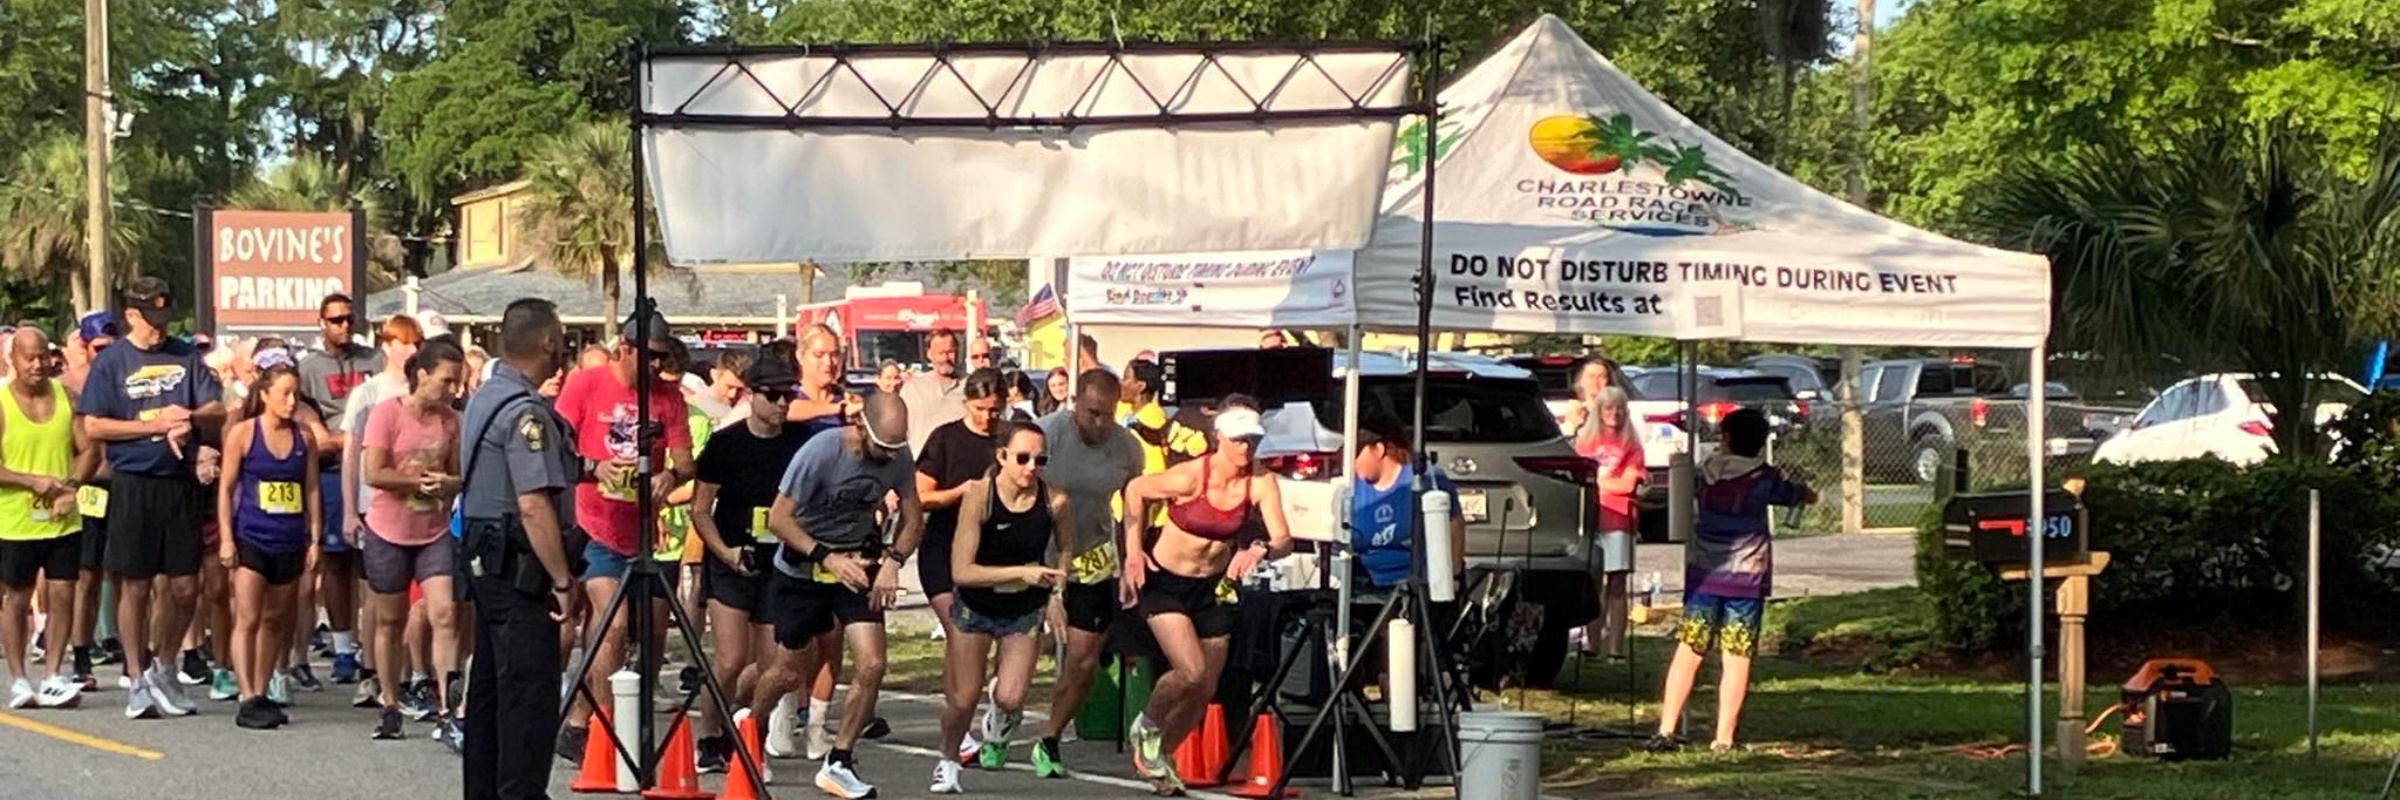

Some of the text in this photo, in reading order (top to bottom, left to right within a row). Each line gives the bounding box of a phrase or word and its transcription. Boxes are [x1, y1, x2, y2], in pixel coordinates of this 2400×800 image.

[1516, 179, 1754, 207] CHARLESTOWNE
[1537, 196, 1706, 214] ROAD RACE
[1571, 208, 1711, 228] SERVICES
[220, 225, 346, 264] BOVINE'S
[1450, 253, 1958, 294] DO NOT DISTURB TIMING DURING EVENT
[1454, 285, 1664, 315] Find Results at
[266, 481, 295, 502] 213
